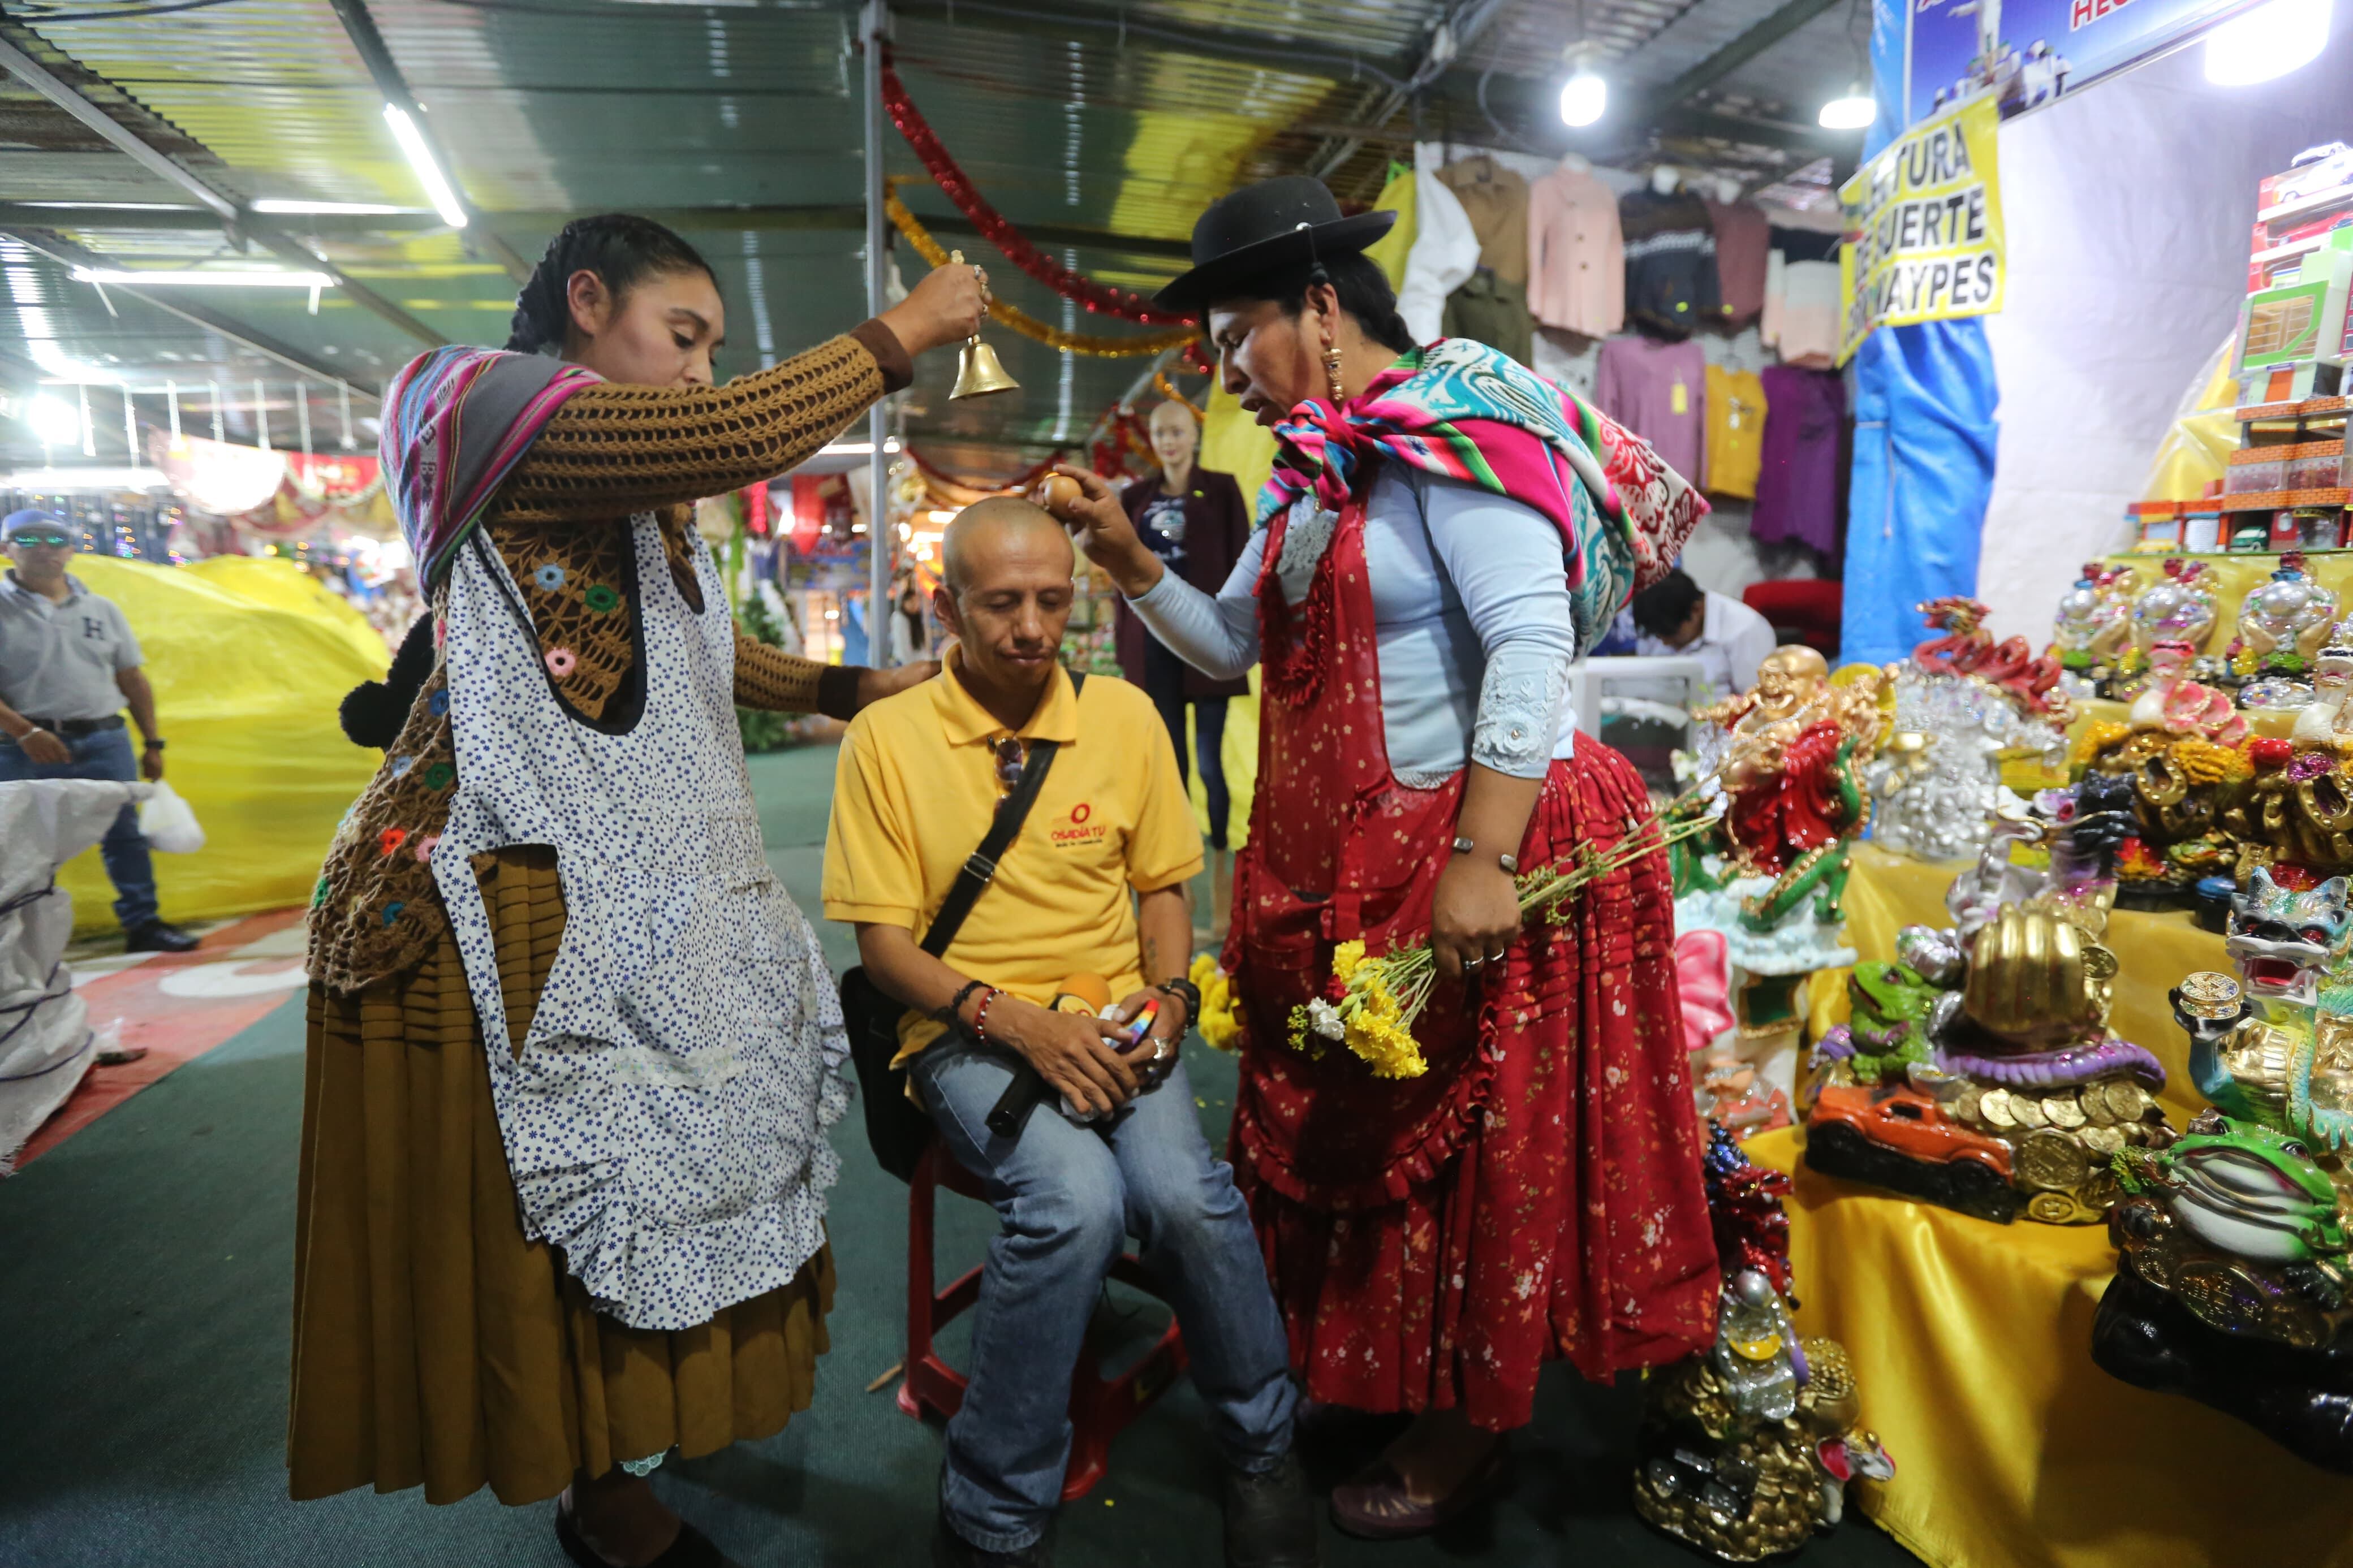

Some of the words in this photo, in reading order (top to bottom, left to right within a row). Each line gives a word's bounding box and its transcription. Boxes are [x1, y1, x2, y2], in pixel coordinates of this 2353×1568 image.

[2074, 0, 2128, 28] HE
[1862, 120, 1971, 222] TURA
[1874, 187, 1984, 264] UERTE
[81, 616, 105, 641] H
